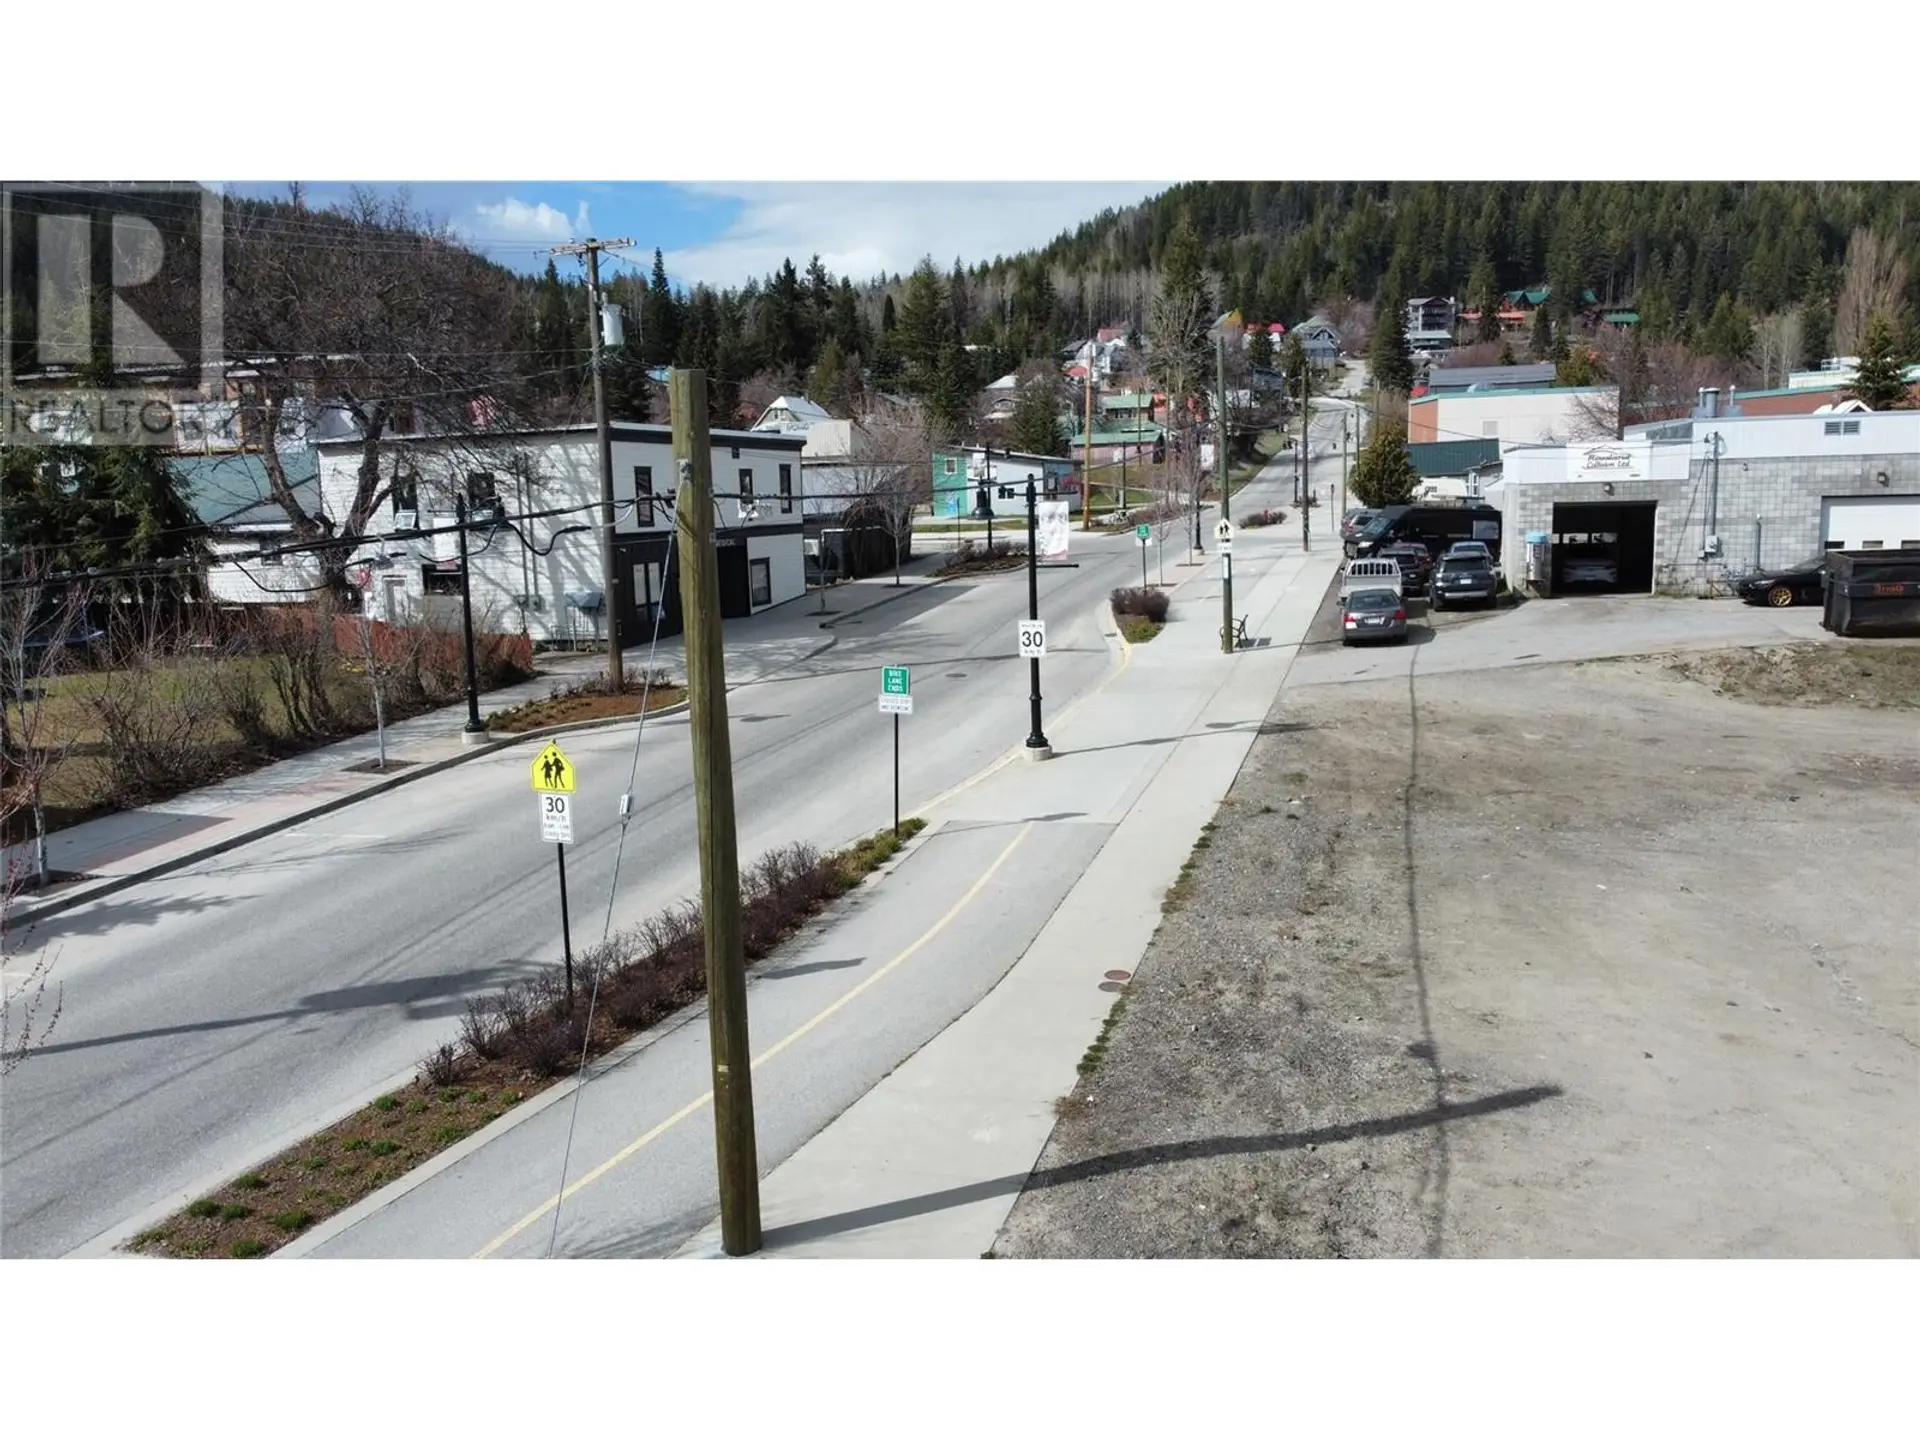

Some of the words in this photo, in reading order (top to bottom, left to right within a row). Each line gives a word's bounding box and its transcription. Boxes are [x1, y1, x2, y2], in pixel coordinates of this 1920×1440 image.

[1022, 630, 1043, 647] 30
[887, 677, 903, 685] LANE
[887, 684, 904, 693] ENDS
[545, 796, 565, 814] 30
